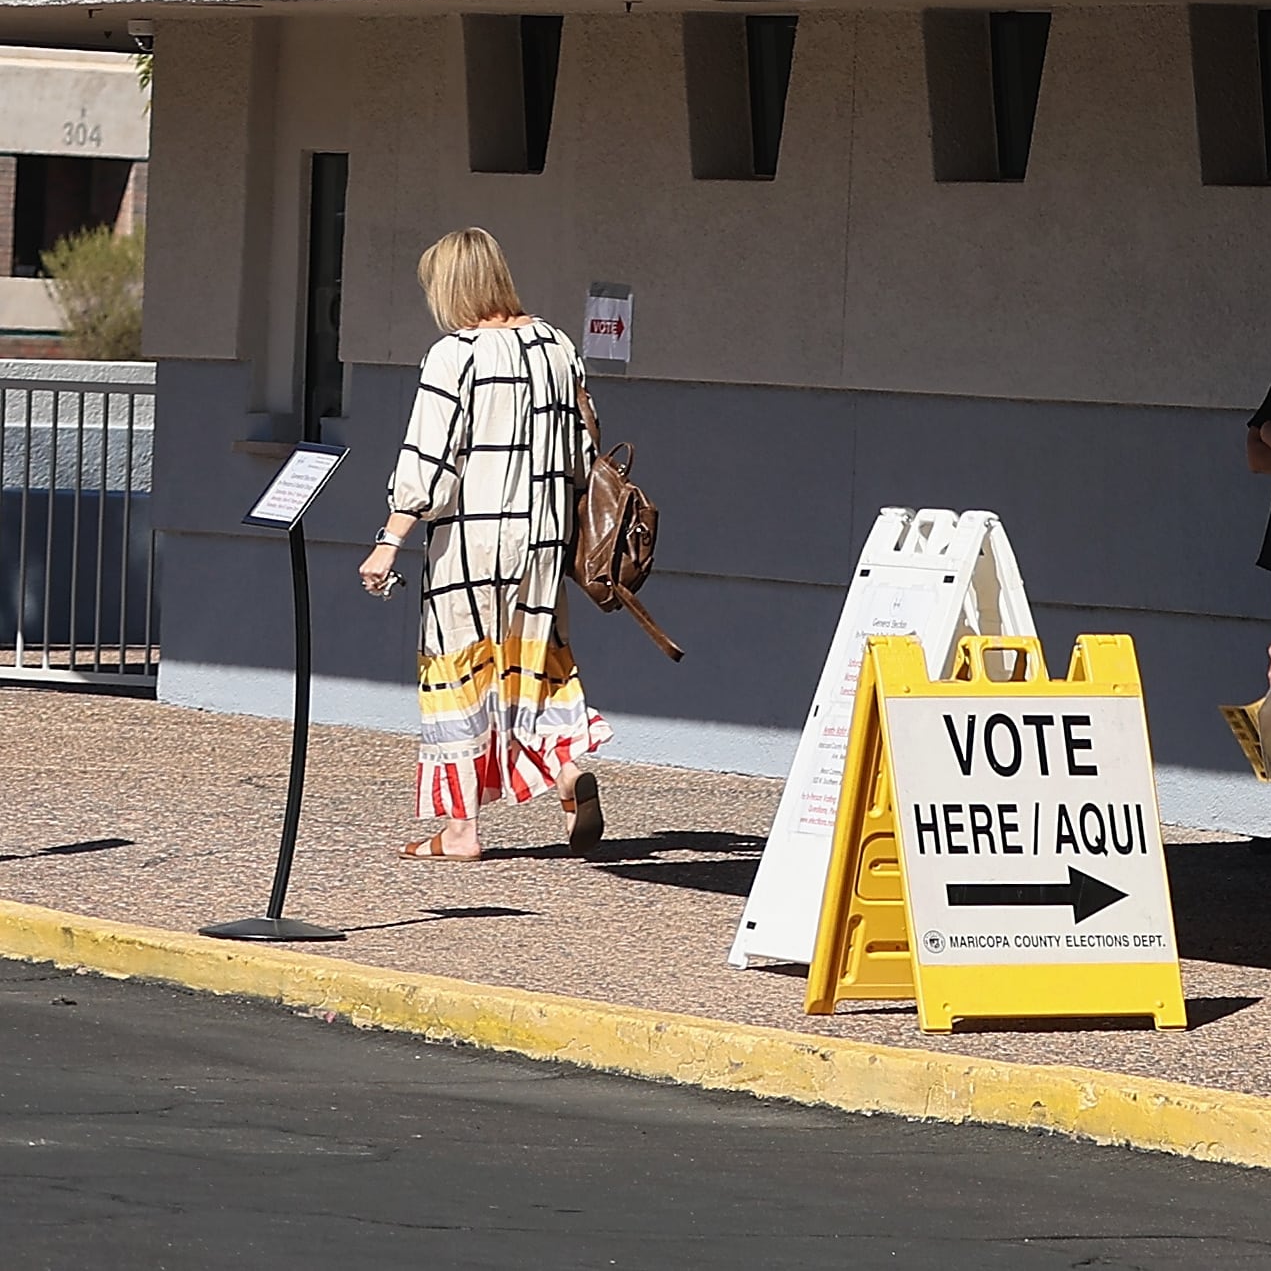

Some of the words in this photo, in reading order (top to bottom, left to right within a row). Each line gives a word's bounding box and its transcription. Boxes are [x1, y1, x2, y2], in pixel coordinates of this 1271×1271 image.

[63, 122, 102, 147] 304
[593, 320, 618, 334] VOTE
[942, 713, 1098, 778] VOTE
[913, 803, 1024, 855] HERE
[1055, 802, 1147, 857] AQUI
[949, 935, 1010, 949] MARICOPA
[1014, 935, 1061, 948] COUNTY
[1065, 935, 1130, 948] ELECTIONS
[1133, 934, 1166, 948] DEPT.
